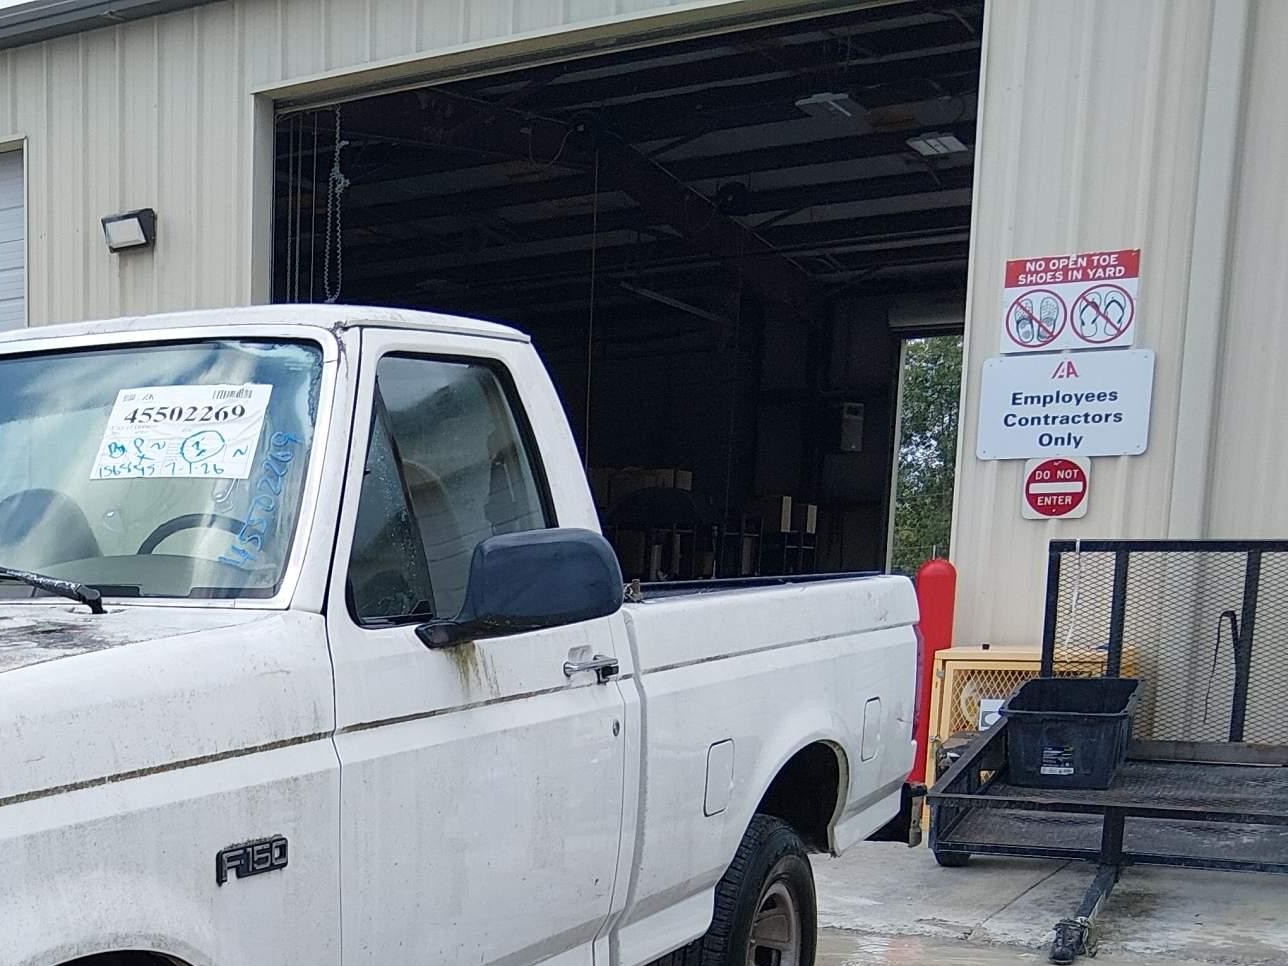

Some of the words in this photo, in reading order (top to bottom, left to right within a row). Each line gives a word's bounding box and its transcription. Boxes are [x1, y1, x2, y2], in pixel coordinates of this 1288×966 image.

[1025, 261, 1045, 272] NO
[1049, 255, 1087, 270] OPEN
[1092, 254, 1118, 267] TOE
[1017, 271, 1063, 285] SHOES
[1068, 269, 1082, 281] IN
[1087, 266, 1125, 280] YARD
[1011, 390, 1119, 407] Employees
[124, 403, 246, 424] 45502269
[1003, 412, 1123, 427] Contractors
[1038, 432, 1083, 449] Only
[1035, 470, 1051, 480] DO
[1057, 469, 1080, 480] NOT
[1037, 495, 1072, 506] ENTER
